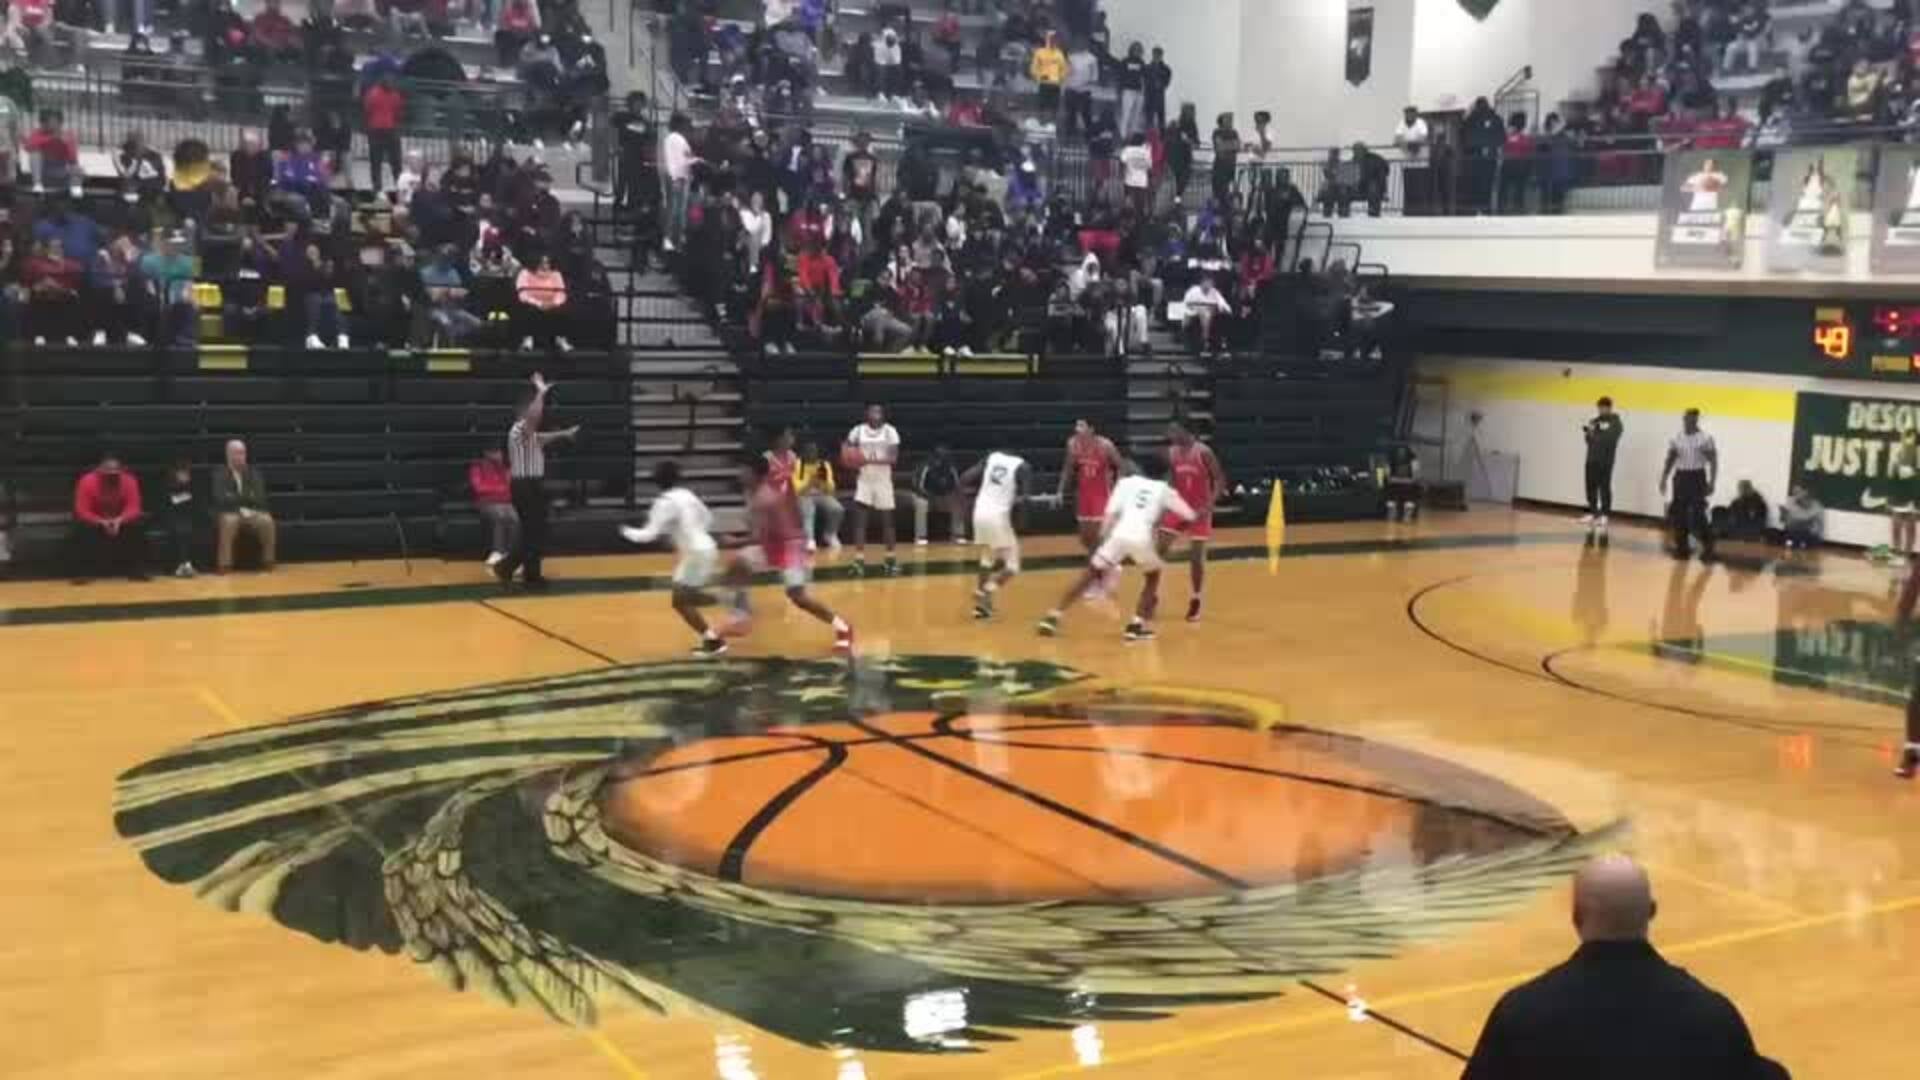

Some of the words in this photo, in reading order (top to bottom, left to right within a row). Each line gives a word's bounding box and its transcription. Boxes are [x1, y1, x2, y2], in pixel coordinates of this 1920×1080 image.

[1815, 326, 1849, 358] 49
[1847, 401, 1920, 433] DESO
[1804, 434, 1884, 478] JUST
